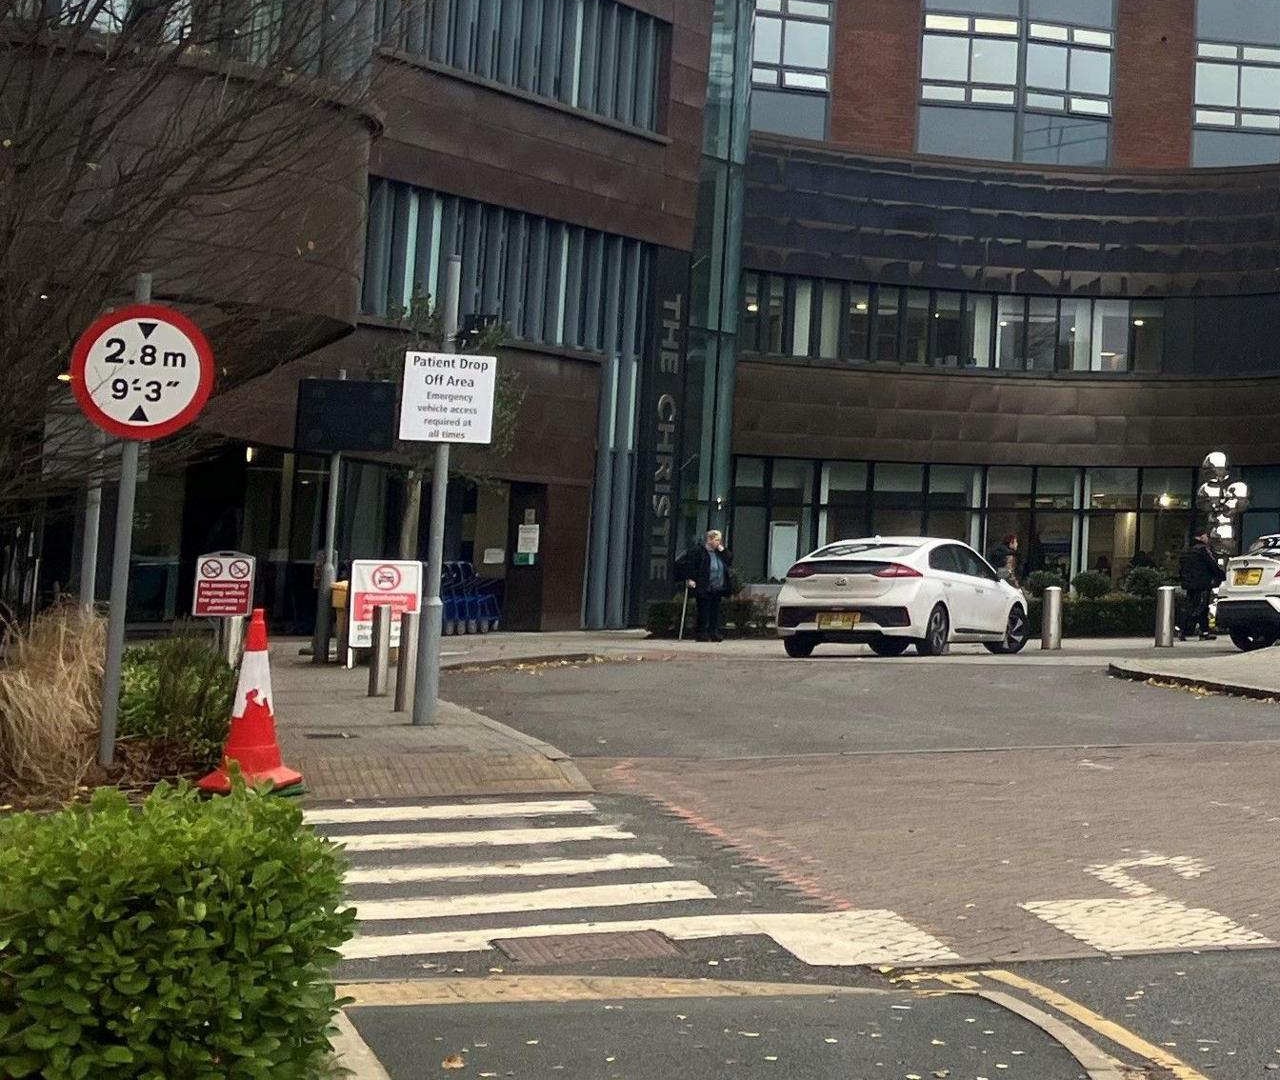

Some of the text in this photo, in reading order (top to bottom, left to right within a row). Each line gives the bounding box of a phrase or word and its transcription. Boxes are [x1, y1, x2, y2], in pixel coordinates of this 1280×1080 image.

[413, 355, 489, 373] Patient Drop
[424, 374, 474, 388] Off Area
[426, 391, 473, 403] Emergency
[417, 405, 478, 415] vehicle access
[424, 418, 472, 427] required at
[428, 429, 465, 439] all times
[652, 294, 682, 580] THE CHRISTIE
